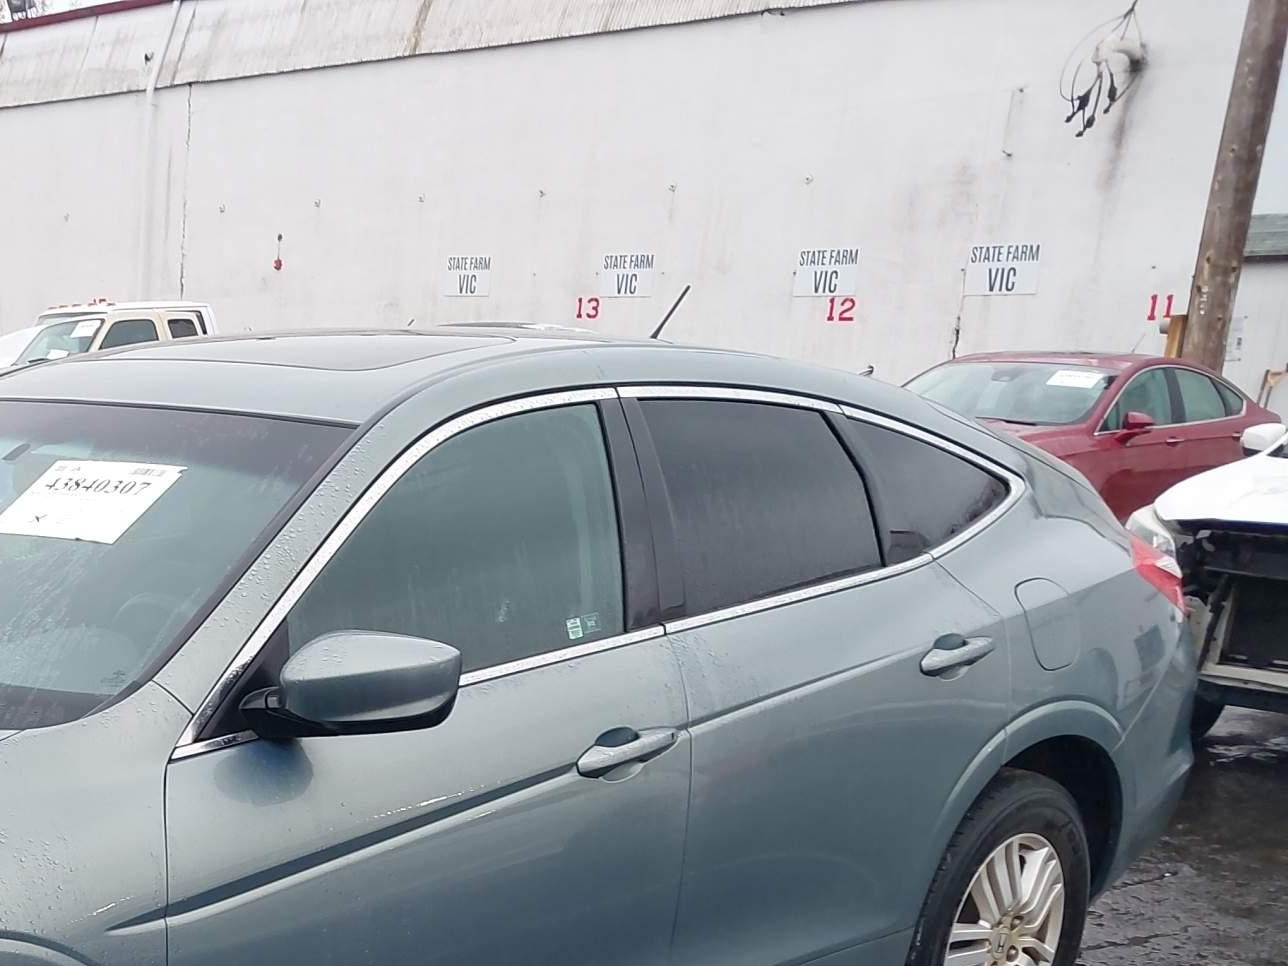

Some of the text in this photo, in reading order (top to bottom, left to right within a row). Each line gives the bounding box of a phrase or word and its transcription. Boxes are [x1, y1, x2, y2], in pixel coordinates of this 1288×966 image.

[447, 256, 491, 271] STATE FARM
[603, 254, 654, 270] STATE FARM
[799, 248, 859, 267] STATE FARM
[970, 244, 1041, 264] STATE FARM
[458, 274, 477, 295] VIC
[616, 273, 638, 295] VIC
[813, 270, 839, 294] VIC
[988, 267, 1017, 292] VIC
[576, 297, 600, 319] 13
[826, 297, 856, 321] 12
[1147, 294, 1174, 320] 11
[45, 477, 152, 496] 43840307
